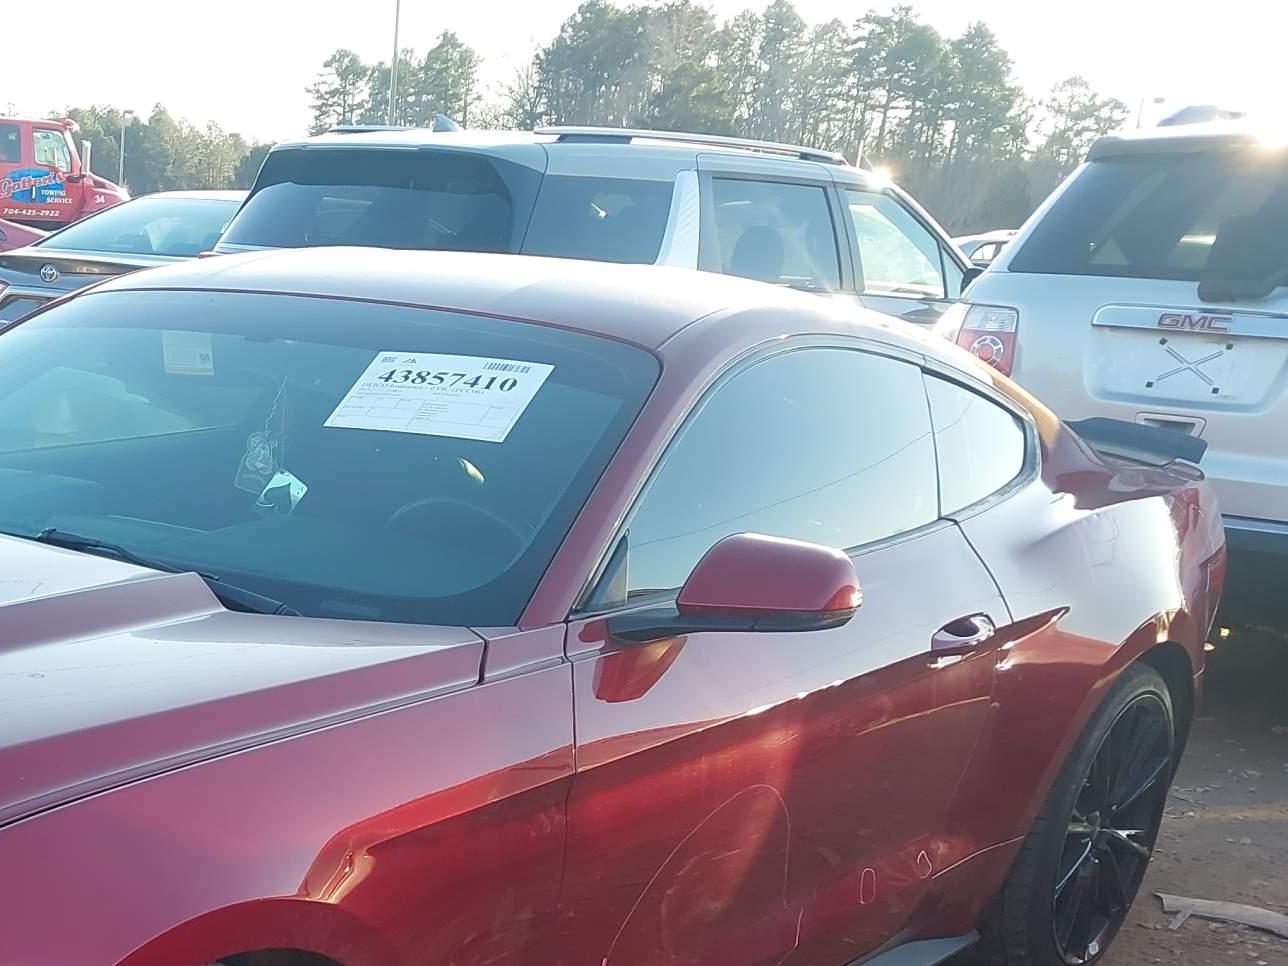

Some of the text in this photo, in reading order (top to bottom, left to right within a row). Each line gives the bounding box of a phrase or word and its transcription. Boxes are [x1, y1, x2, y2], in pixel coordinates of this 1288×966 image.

[94, 195, 105, 204] 34
[2, 208, 61, 217] 704-425-2922
[1158, 313, 1232, 331] GMC
[378, 368, 518, 392] 43857410
